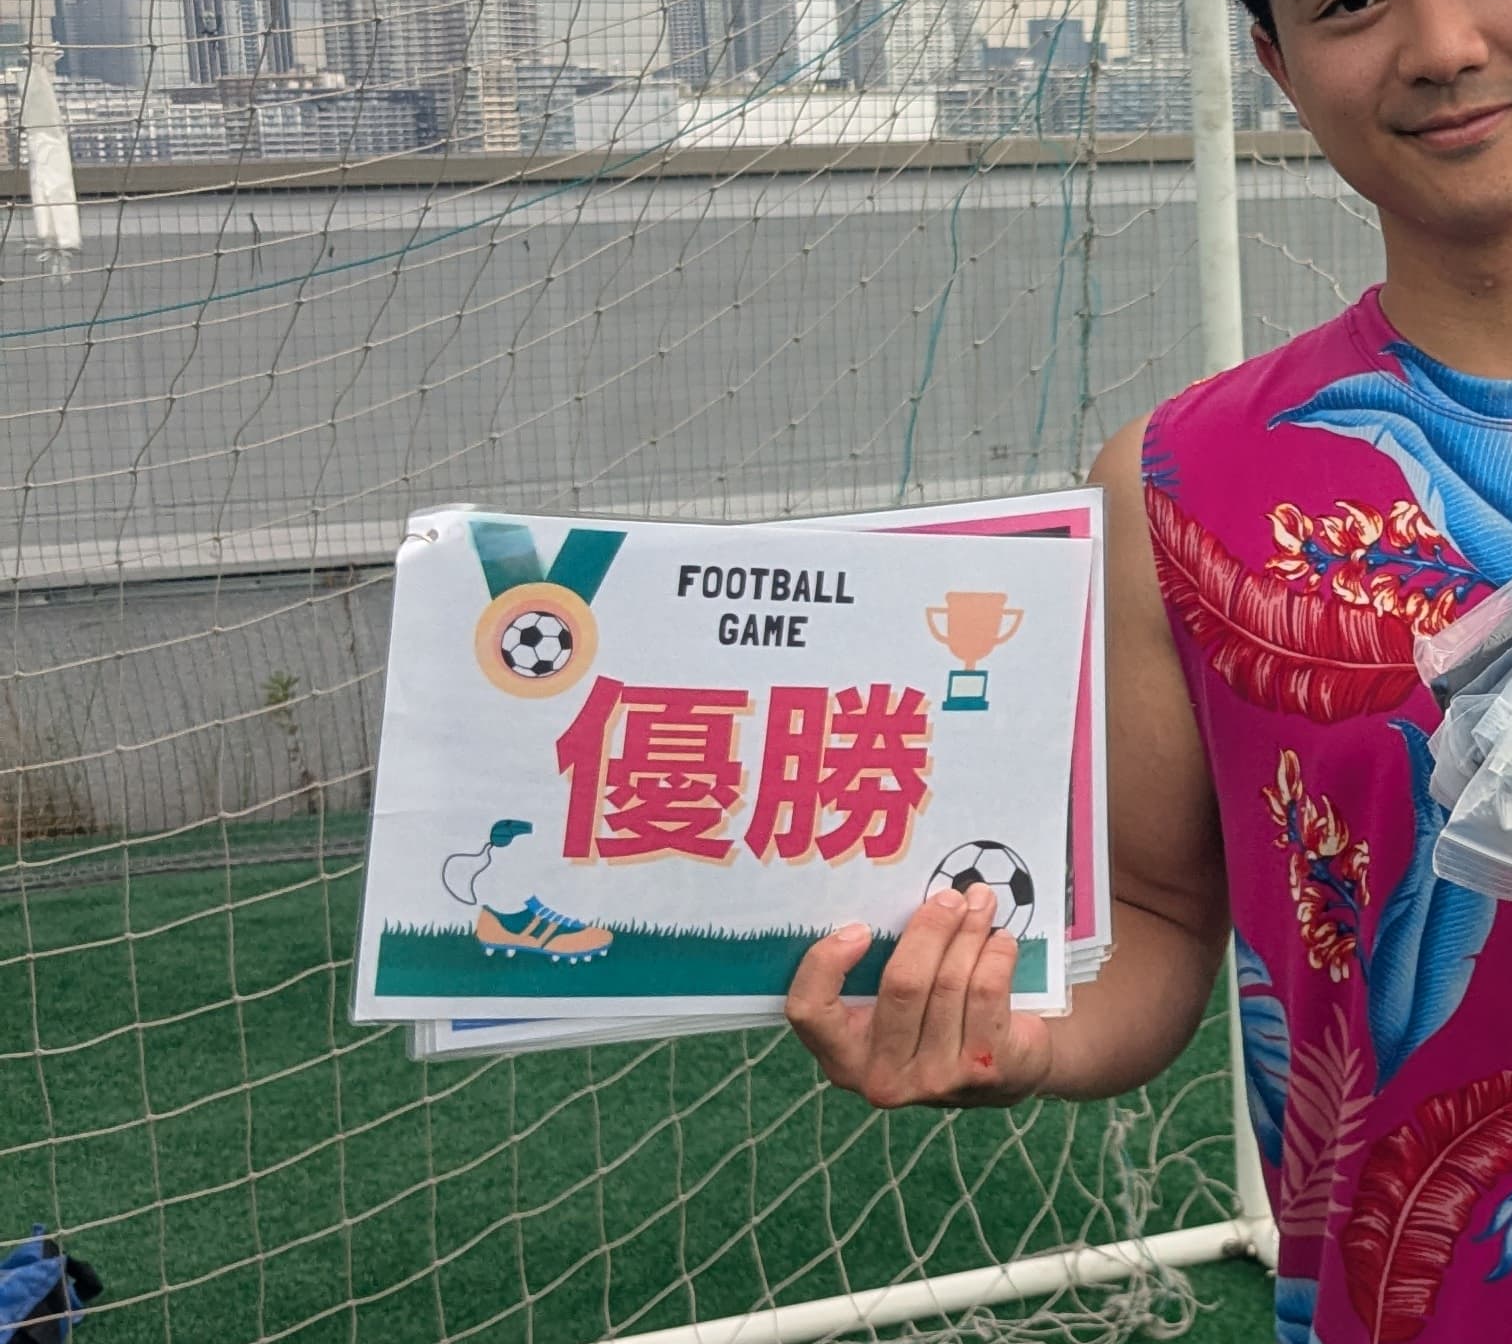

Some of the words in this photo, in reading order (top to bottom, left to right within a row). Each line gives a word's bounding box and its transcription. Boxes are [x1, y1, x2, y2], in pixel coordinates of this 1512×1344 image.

[676, 564, 855, 605] FOOTBALL
[718, 613, 809, 648] GAME
[555, 675, 931, 867] 優勝
